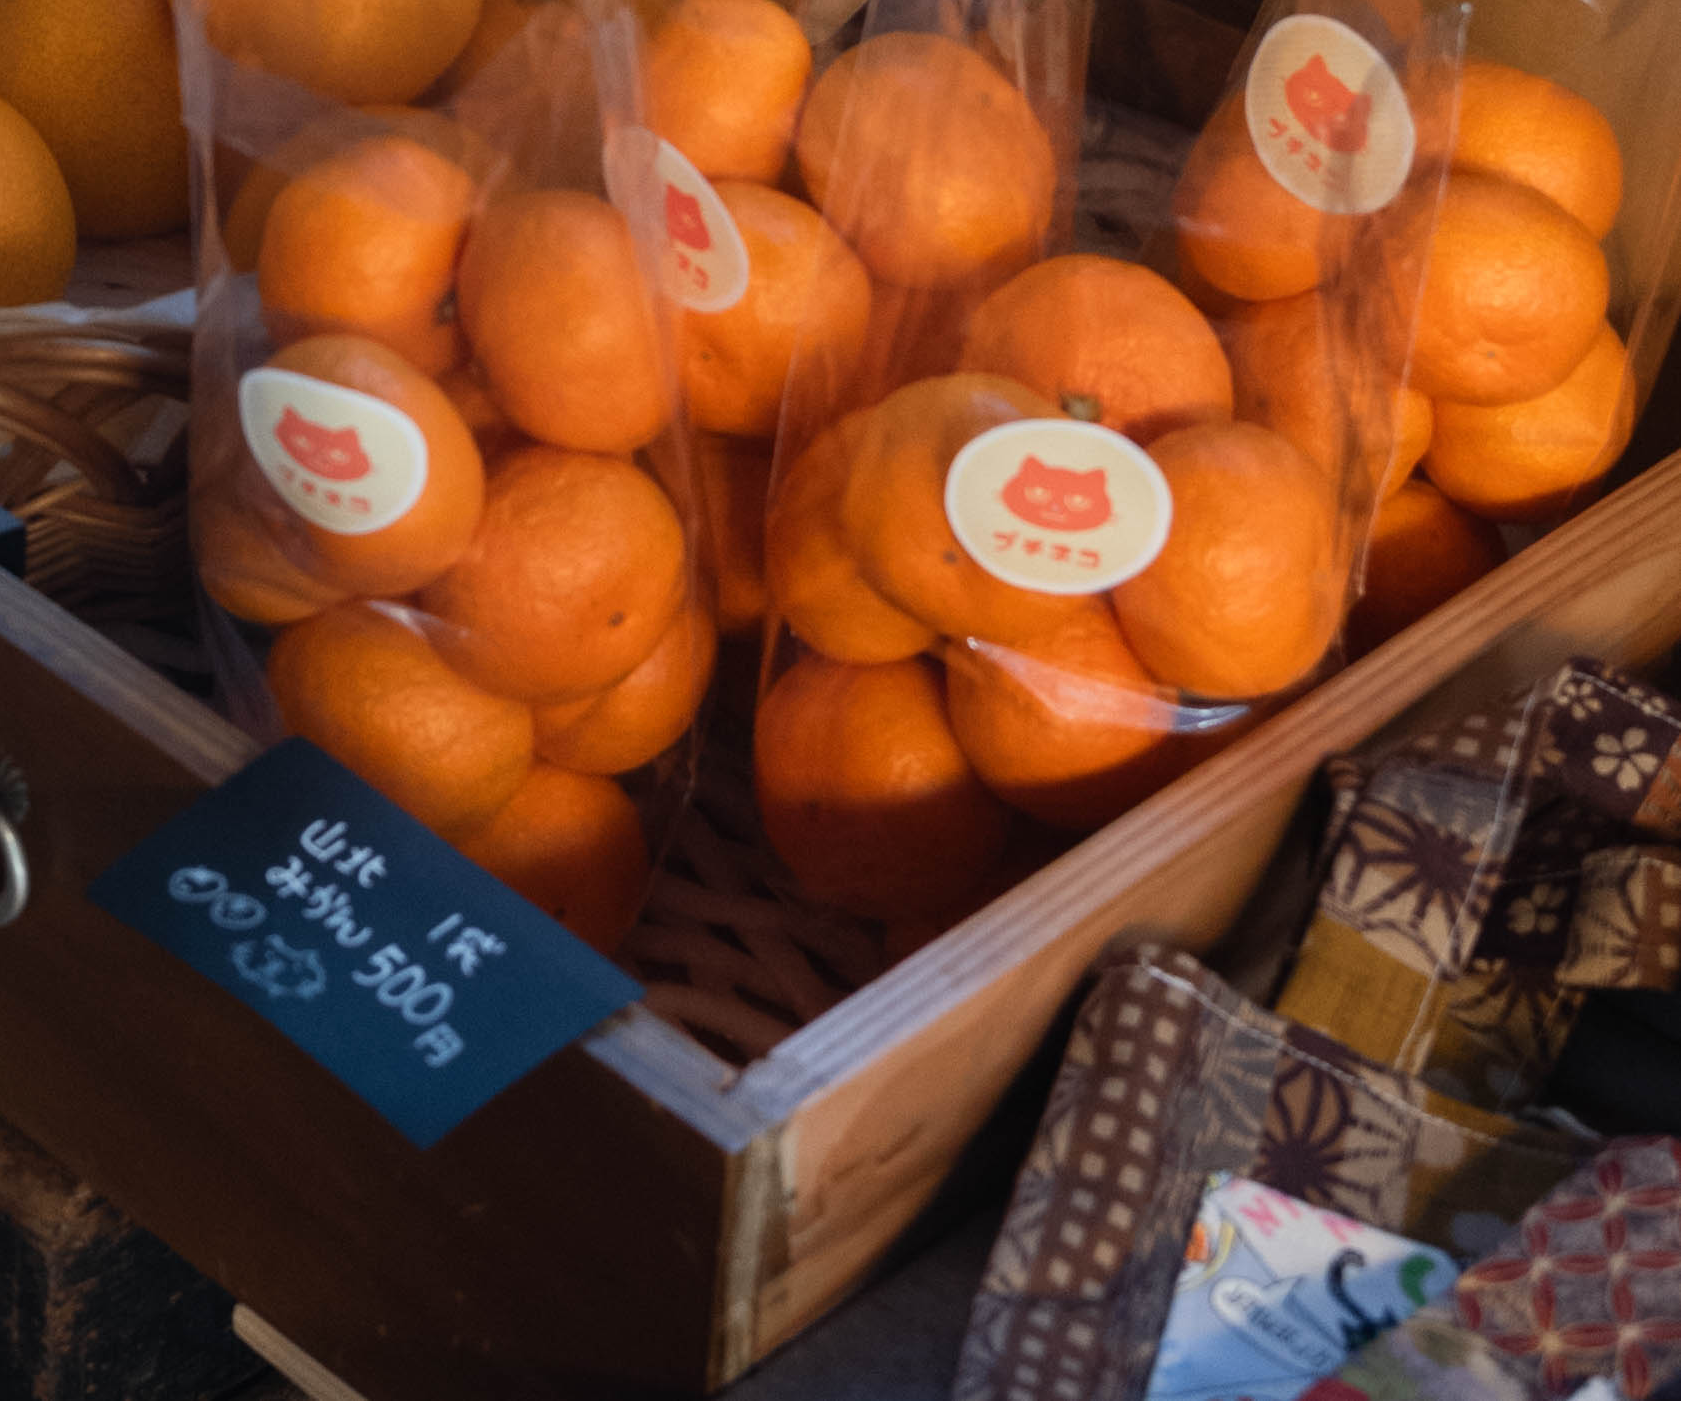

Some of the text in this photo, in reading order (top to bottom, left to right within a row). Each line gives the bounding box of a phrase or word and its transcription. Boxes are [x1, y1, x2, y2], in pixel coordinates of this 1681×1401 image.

[298, 817, 388, 889] 山北
[263, 853, 466, 1069] みかん 500円
